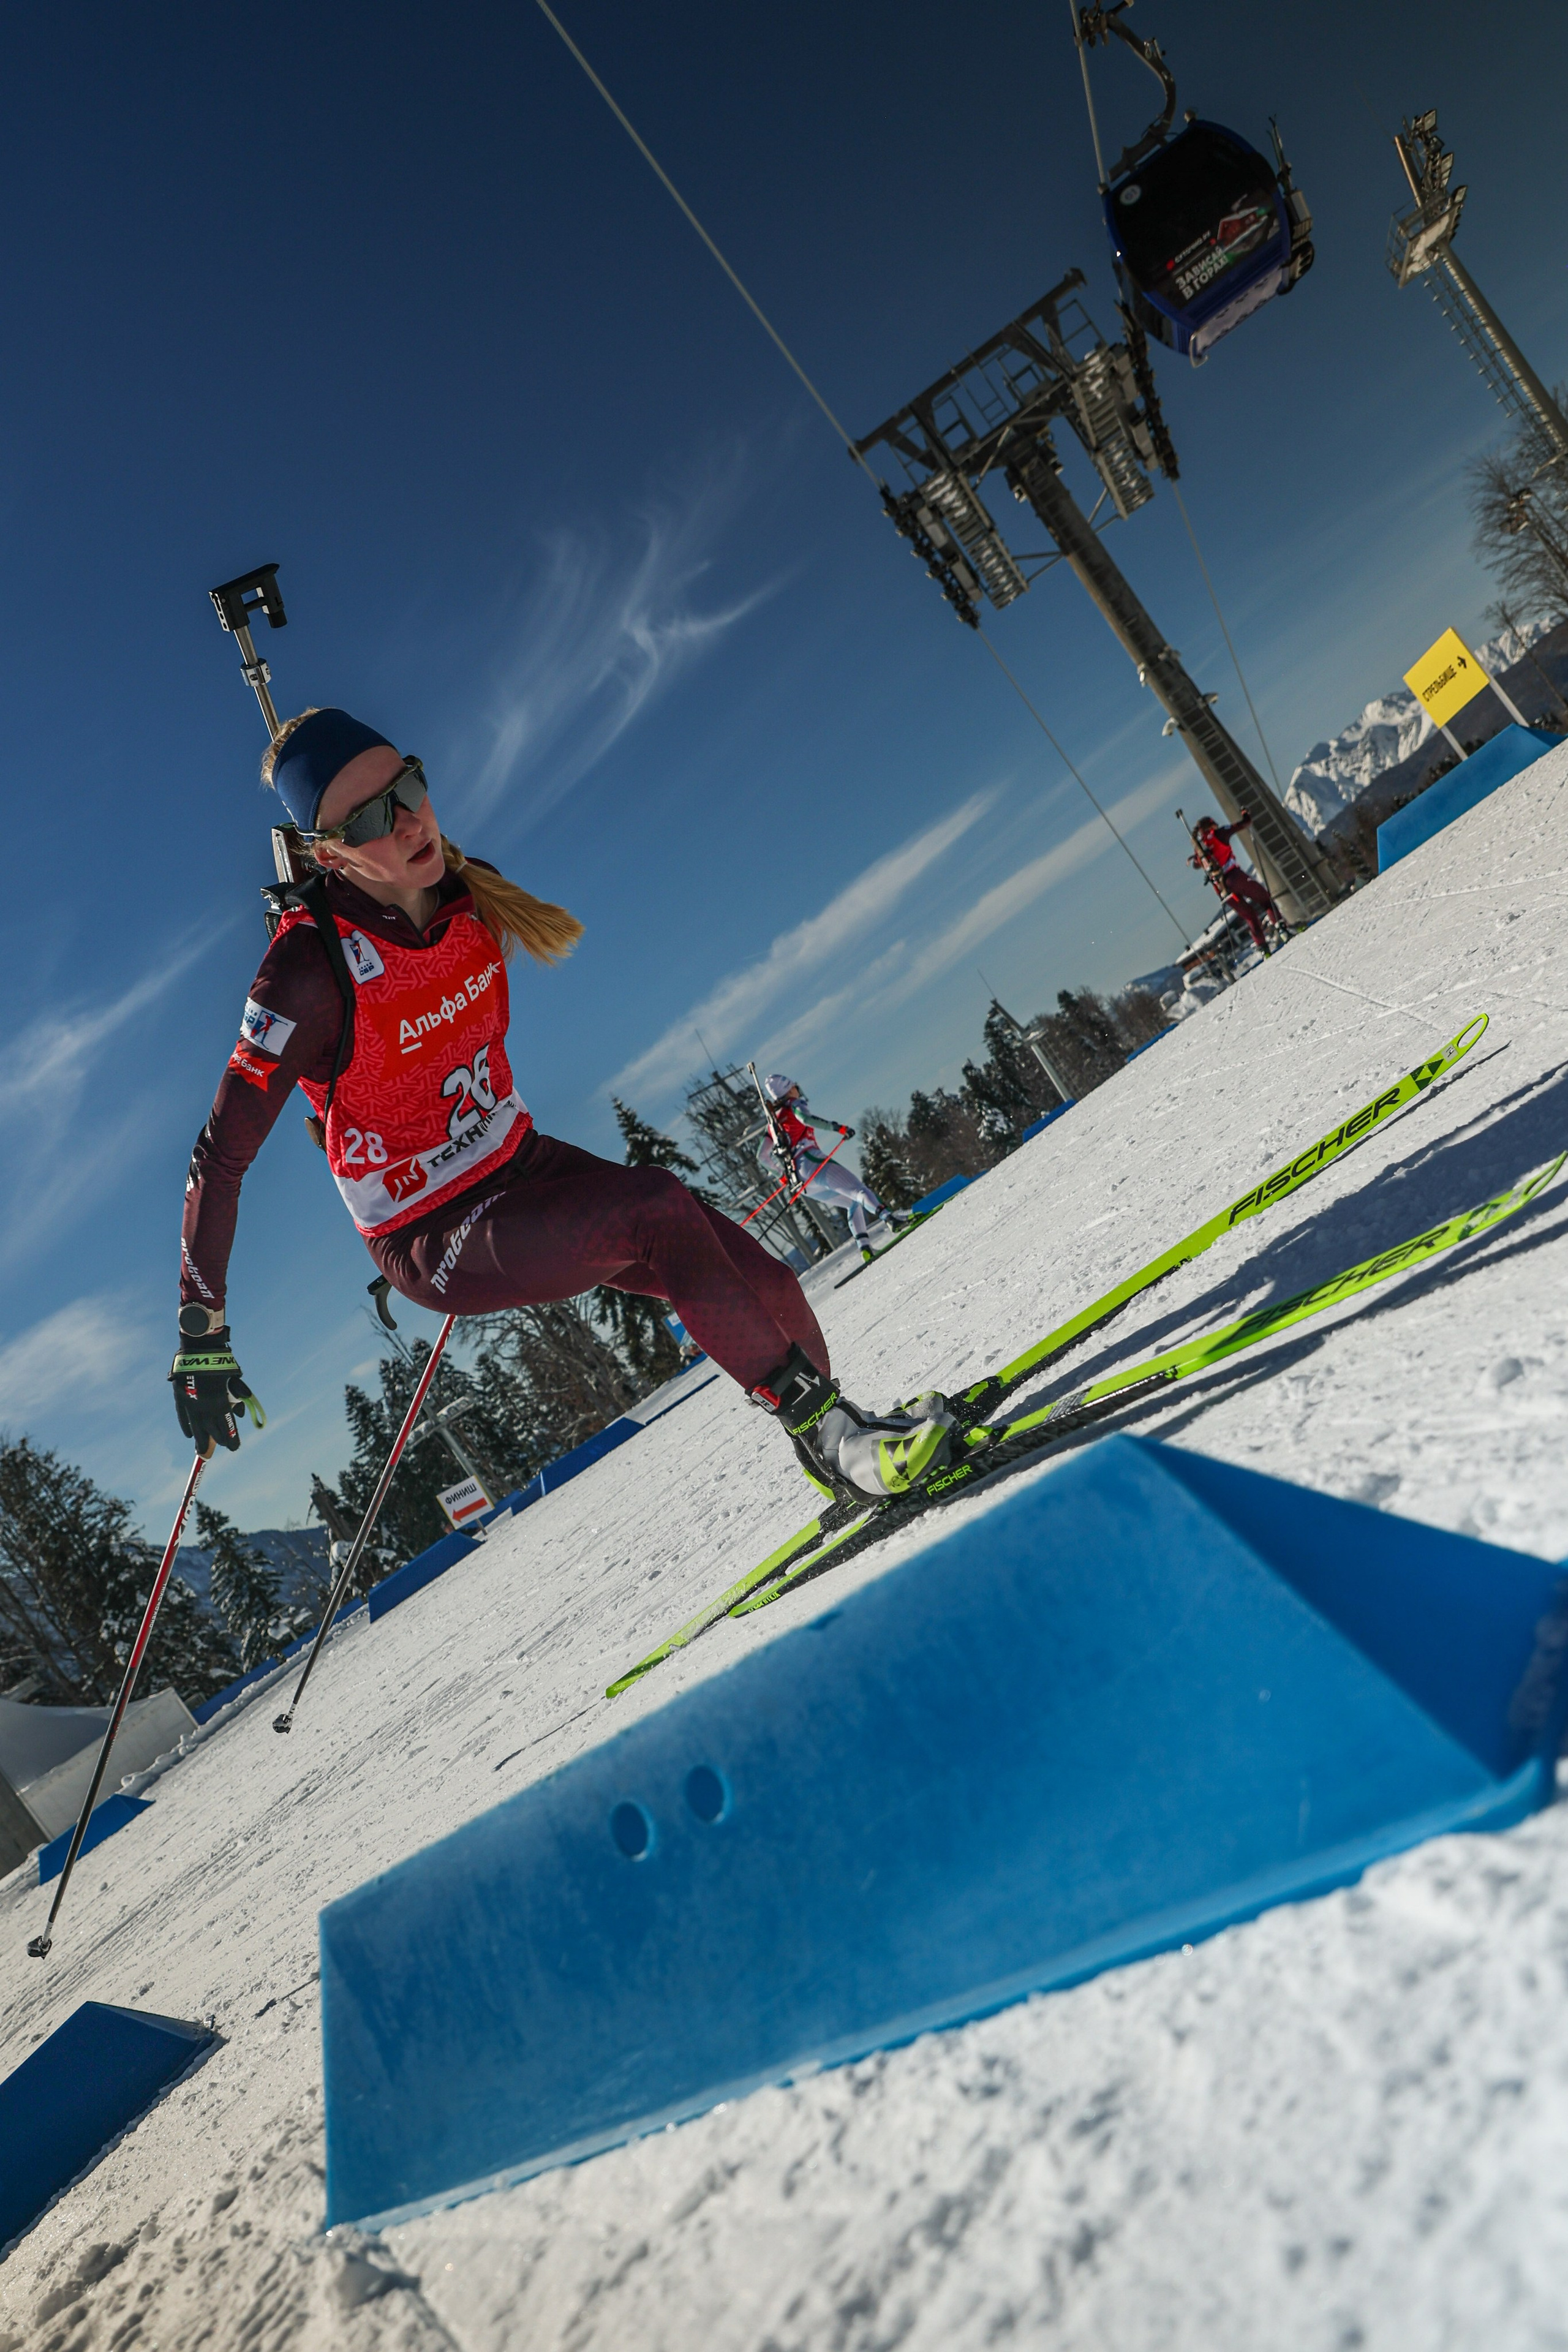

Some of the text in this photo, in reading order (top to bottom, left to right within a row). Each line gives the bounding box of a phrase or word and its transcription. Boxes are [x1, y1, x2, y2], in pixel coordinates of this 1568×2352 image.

[1176, 246, 1223, 290] ЗАВИСАЙ
[1182, 285, 1194, 300] В
[1422, 664, 1457, 702] СТРЕЛЬБИЩЕ
[360, 965, 375, 976] СБР
[399, 996, 468, 1045] Альфа
[241, 1058, 265, 1077] Банк
[344, 1127, 388, 1164] 28
[1228, 1087, 1401, 1226] FISCHER
[1226, 1226, 1450, 1341] FISCHER
[792, 1392, 838, 1436] FISCHER
[445, 1482, 477, 1504] ФИНИШ
[926, 1464, 973, 1496] FISCHER
